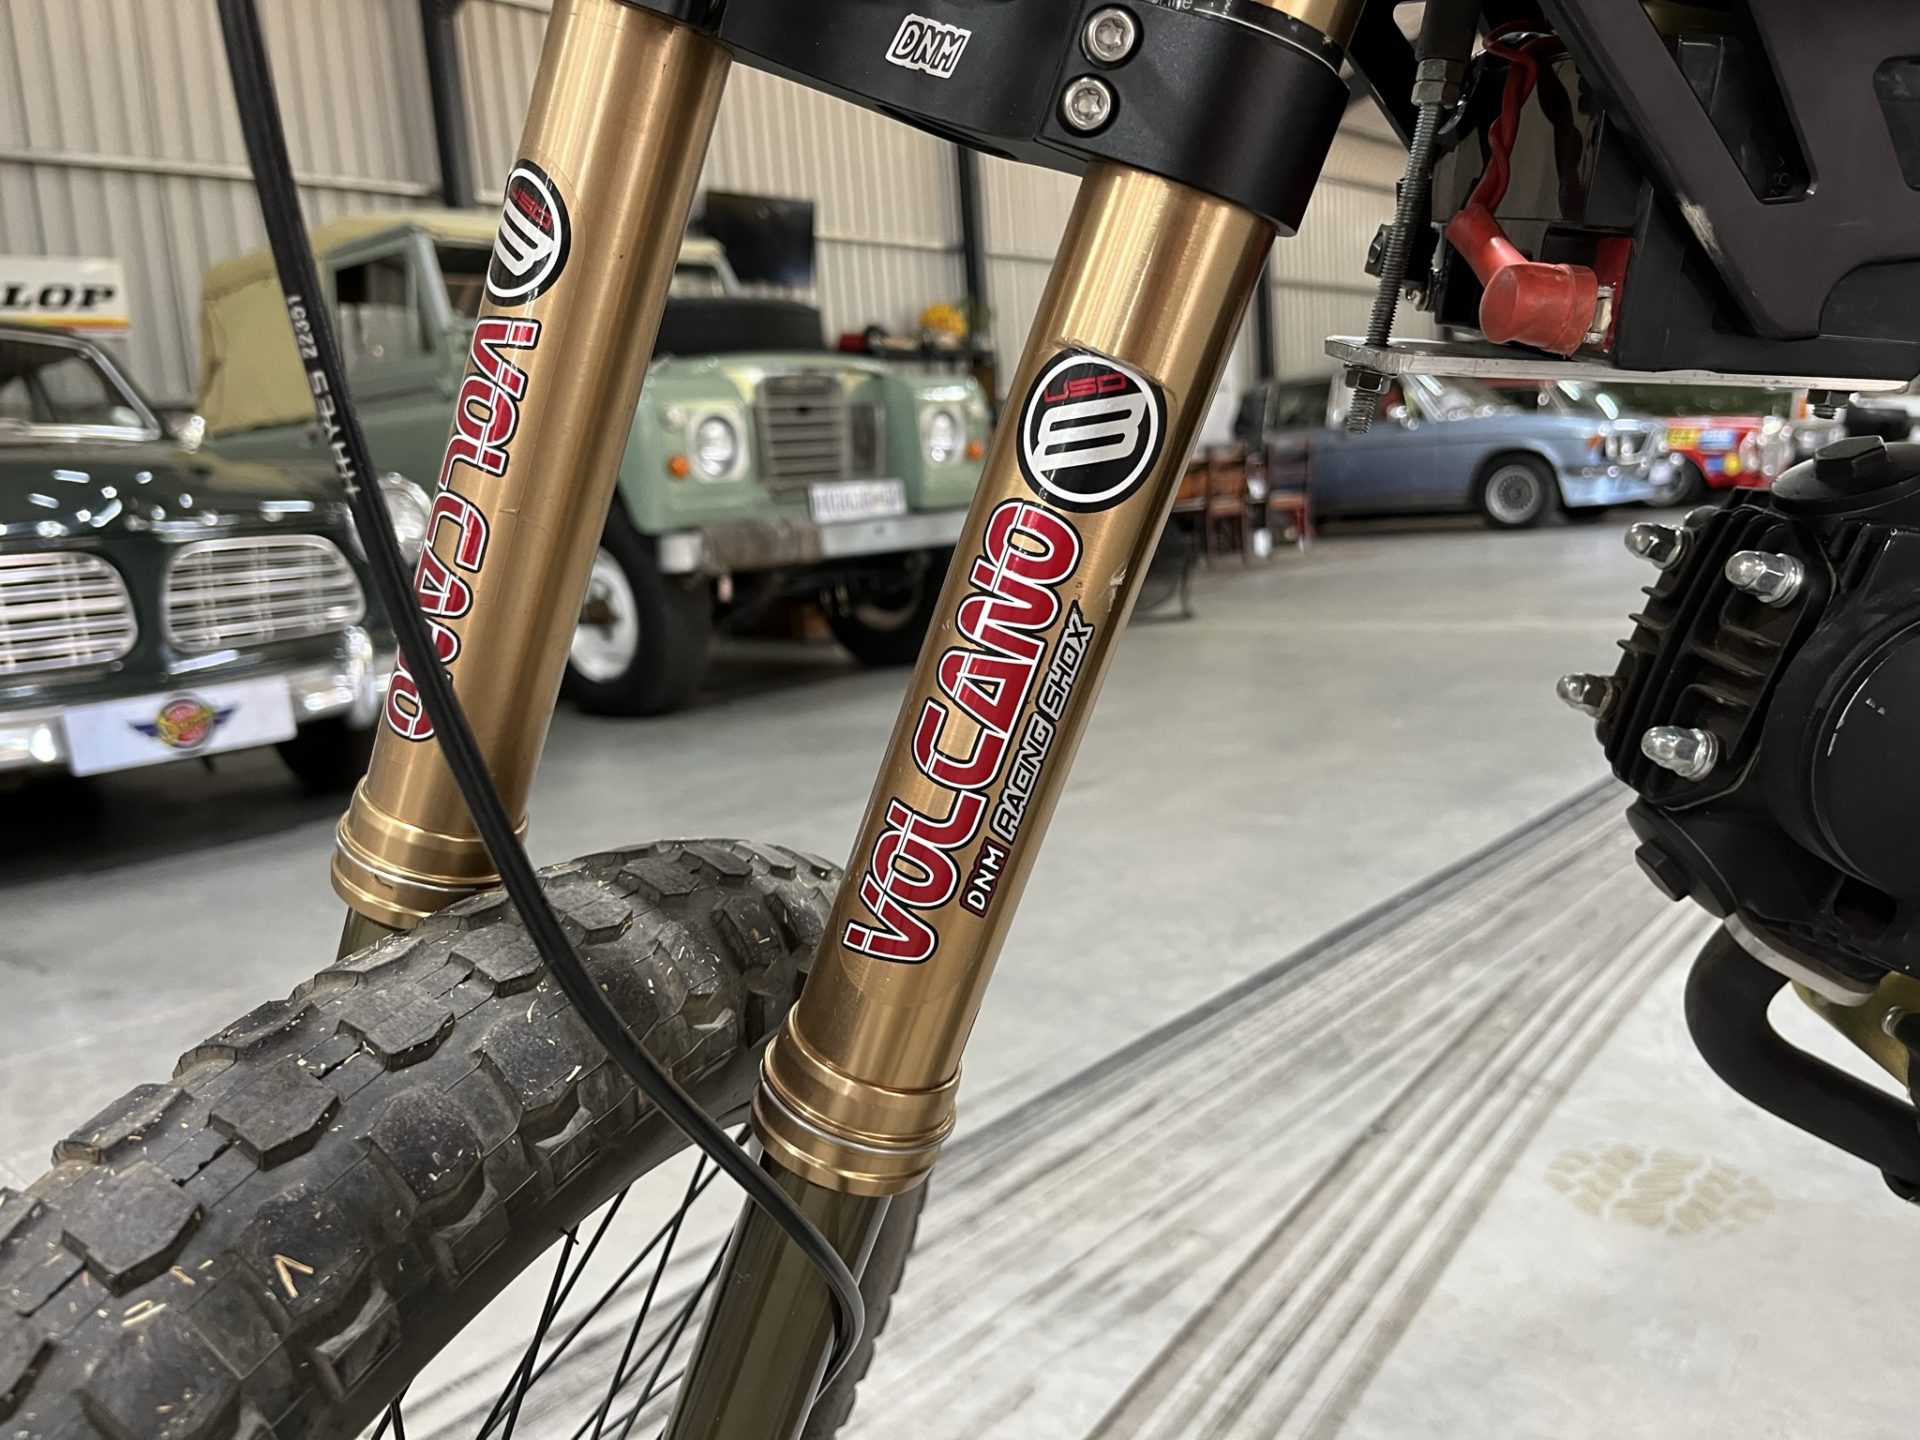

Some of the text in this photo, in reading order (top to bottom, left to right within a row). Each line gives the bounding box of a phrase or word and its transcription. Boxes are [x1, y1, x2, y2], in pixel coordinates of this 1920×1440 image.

[890, 19, 968, 74] DNM
[1043, 372, 1128, 404] USD
[842, 499, 1082, 964] VOLCANO
[963, 602, 1094, 913] DNM RACING SHOX
